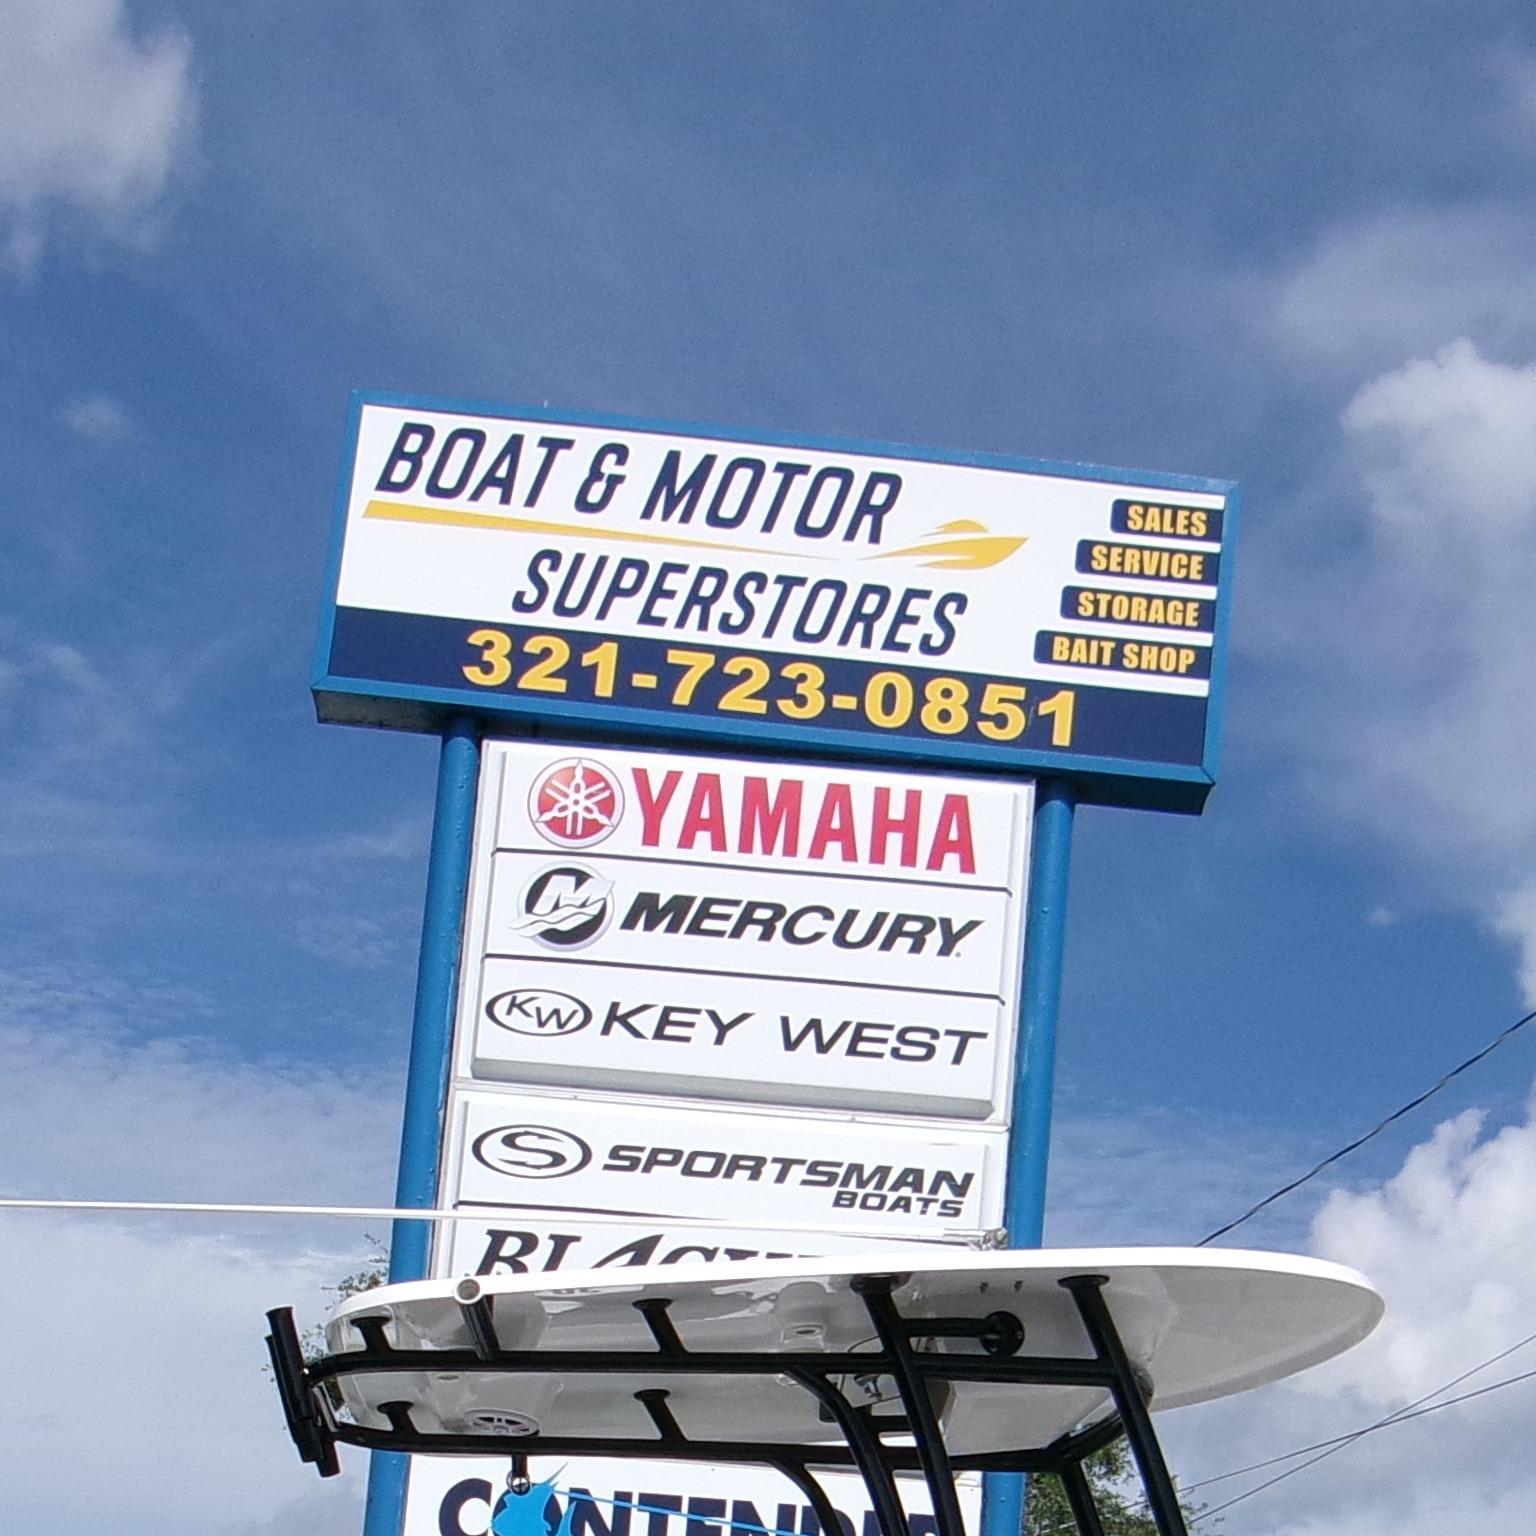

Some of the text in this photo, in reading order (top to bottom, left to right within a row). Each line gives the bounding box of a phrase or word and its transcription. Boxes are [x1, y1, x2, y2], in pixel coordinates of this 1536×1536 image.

[374, 421, 904, 545] BOAT & MOTOR
[1126, 504, 1208, 538] SALES
[1090, 544, 1205, 582] SERVICE
[511, 548, 969, 656] SUPERSTORES
[1076, 590, 1200, 628] STORAGE
[1052, 635, 1196, 674] BAIT SHOP
[462, 627, 1077, 746] 321-723-0851
[631, 767, 977, 875] YAMAHA
[619, 892, 984, 958] MERCURY
[505, 994, 989, 1067] KW KEY WEST
[602, 1144, 975, 1199] SPORTSMAN
[832, 1191, 964, 1218] BOATS
